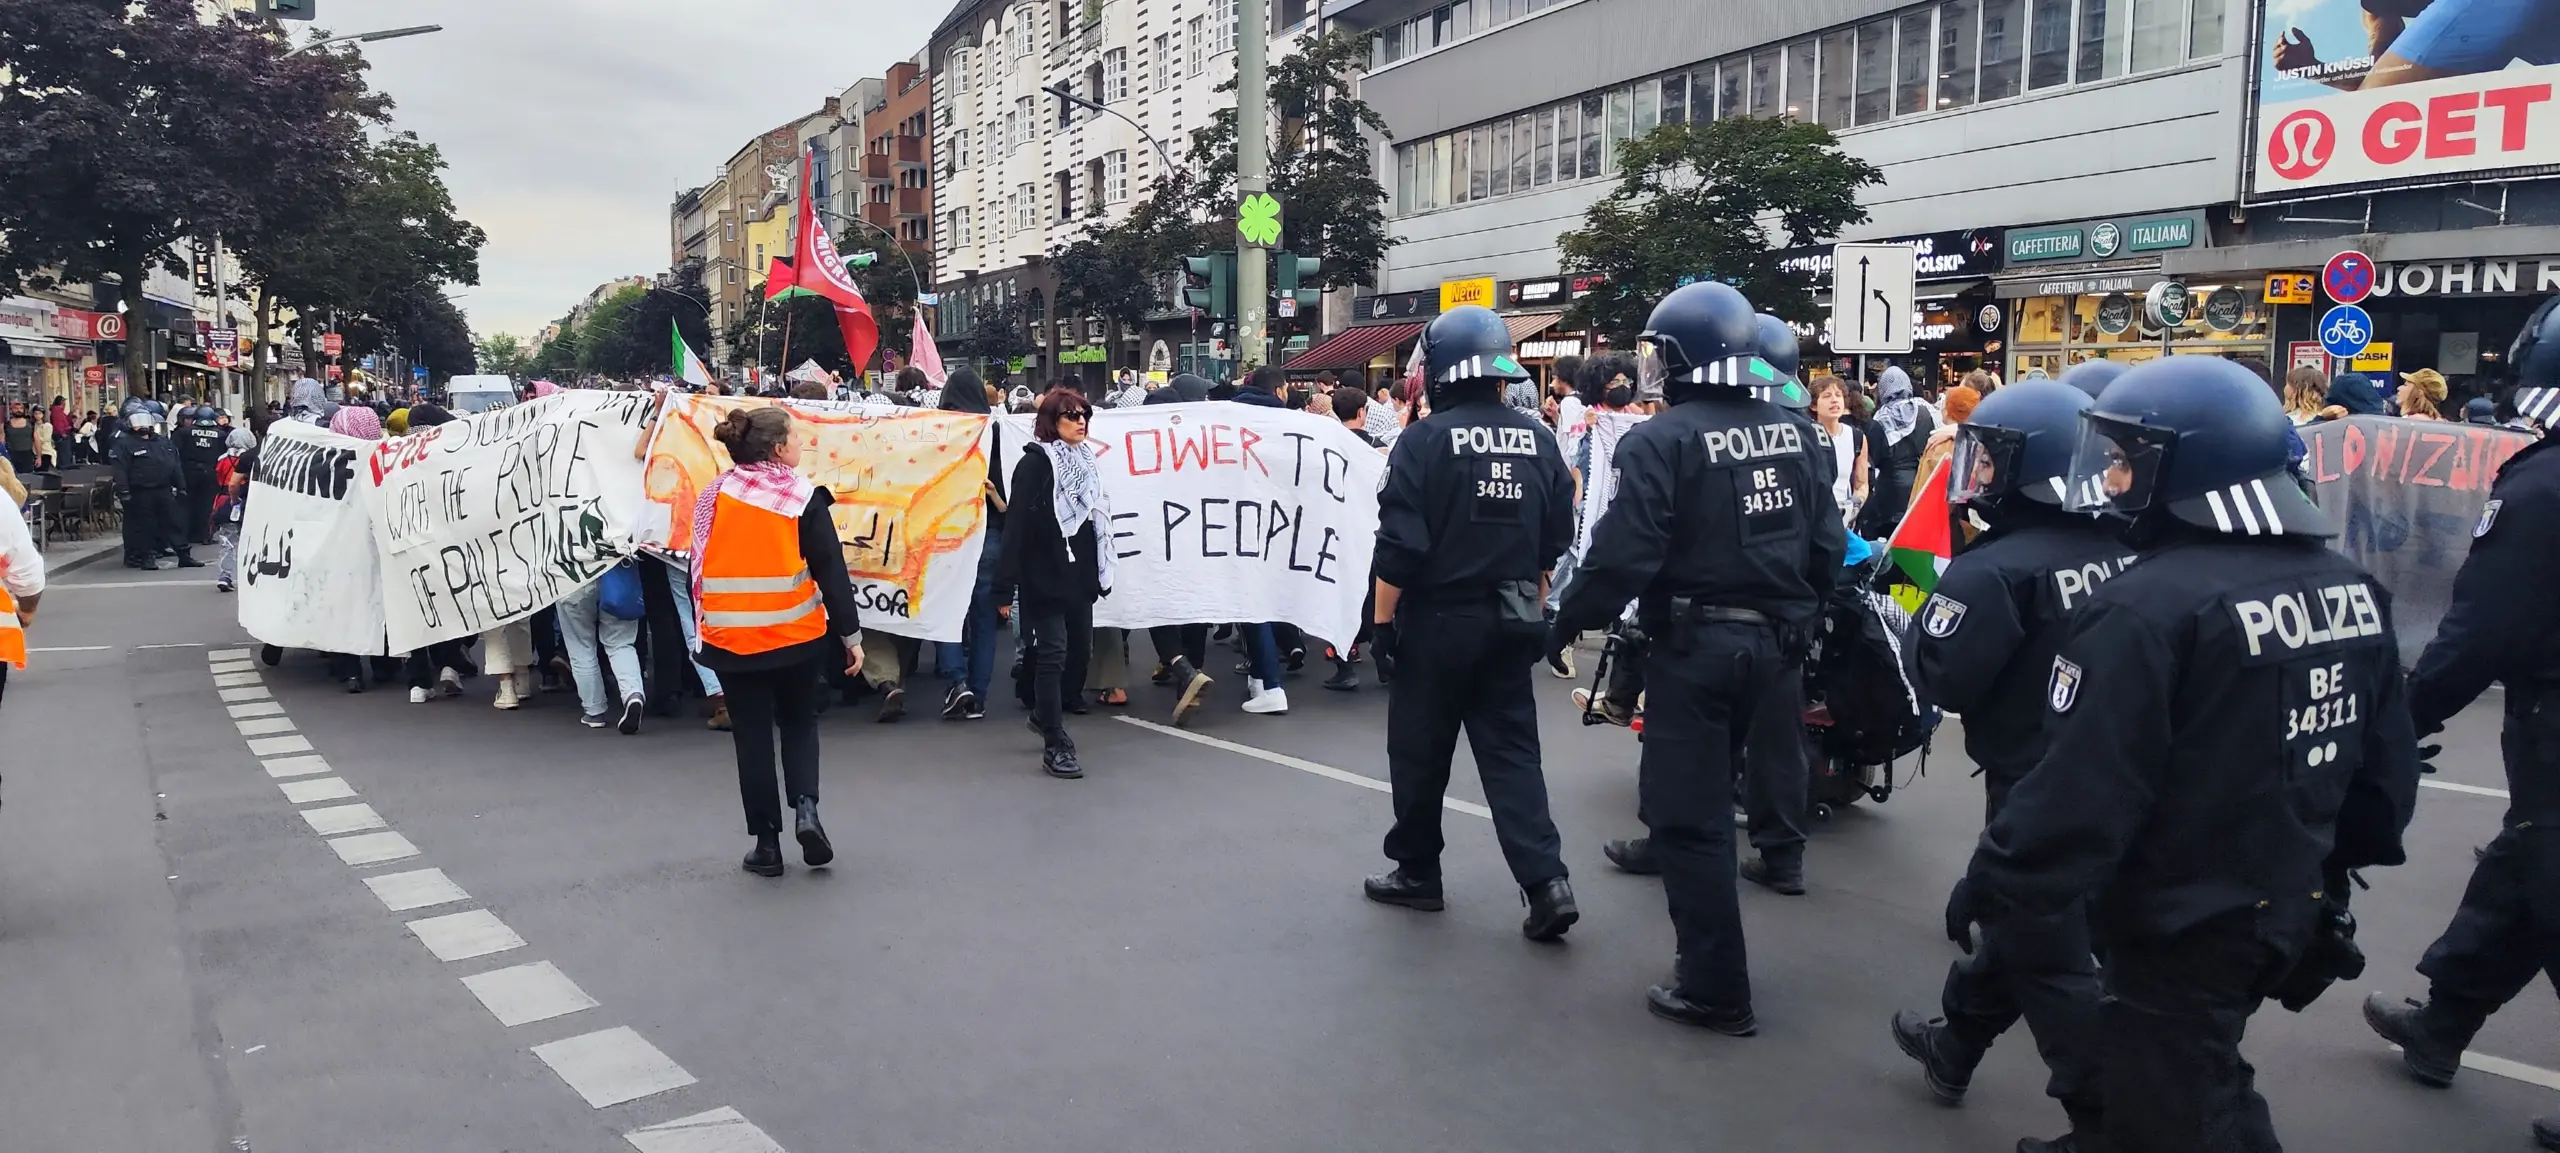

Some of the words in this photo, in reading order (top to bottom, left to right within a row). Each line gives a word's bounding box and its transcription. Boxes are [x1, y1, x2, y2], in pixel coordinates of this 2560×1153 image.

[2273, 63, 2322, 82] JUSTIN
[2323, 54, 2376, 75] KNÜSSI
[2362, 84, 2552, 165] GET
[2012, 234, 2080, 256] CAFFETTERIA
[2133, 224, 2188, 245] ITALIANA
[194, 235, 209, 286] OTEL
[1451, 282, 1483, 303] Netto
[2039, 282, 2084, 295] CAFFETTERIA
[2099, 278, 2133, 291] ITALIANA
[2372, 261, 2518, 297] JOHN
[2356, 353, 2389, 361] CASH
[1450, 426, 1538, 456] POLIZEI
[1702, 422, 1803, 464] POLIZEI
[1283, 432, 1348, 503] TO
[1491, 462, 1512, 480] BE
[1753, 467, 1778, 489] BE
[440, 466, 472, 523] THE
[1476, 480, 1523, 499] 34316
[1742, 487, 1794, 516] 34315
[1163, 497, 1341, 585] PEOPLE
[411, 563, 442, 629] OF
[440, 504, 607, 632] PALESTINE
[1932, 596, 1963, 614] POLIZEI
[2235, 583, 2382, 656] POLIZEI
[2310, 662, 2344, 700] BE
[2286, 692, 2357, 741] 34311
